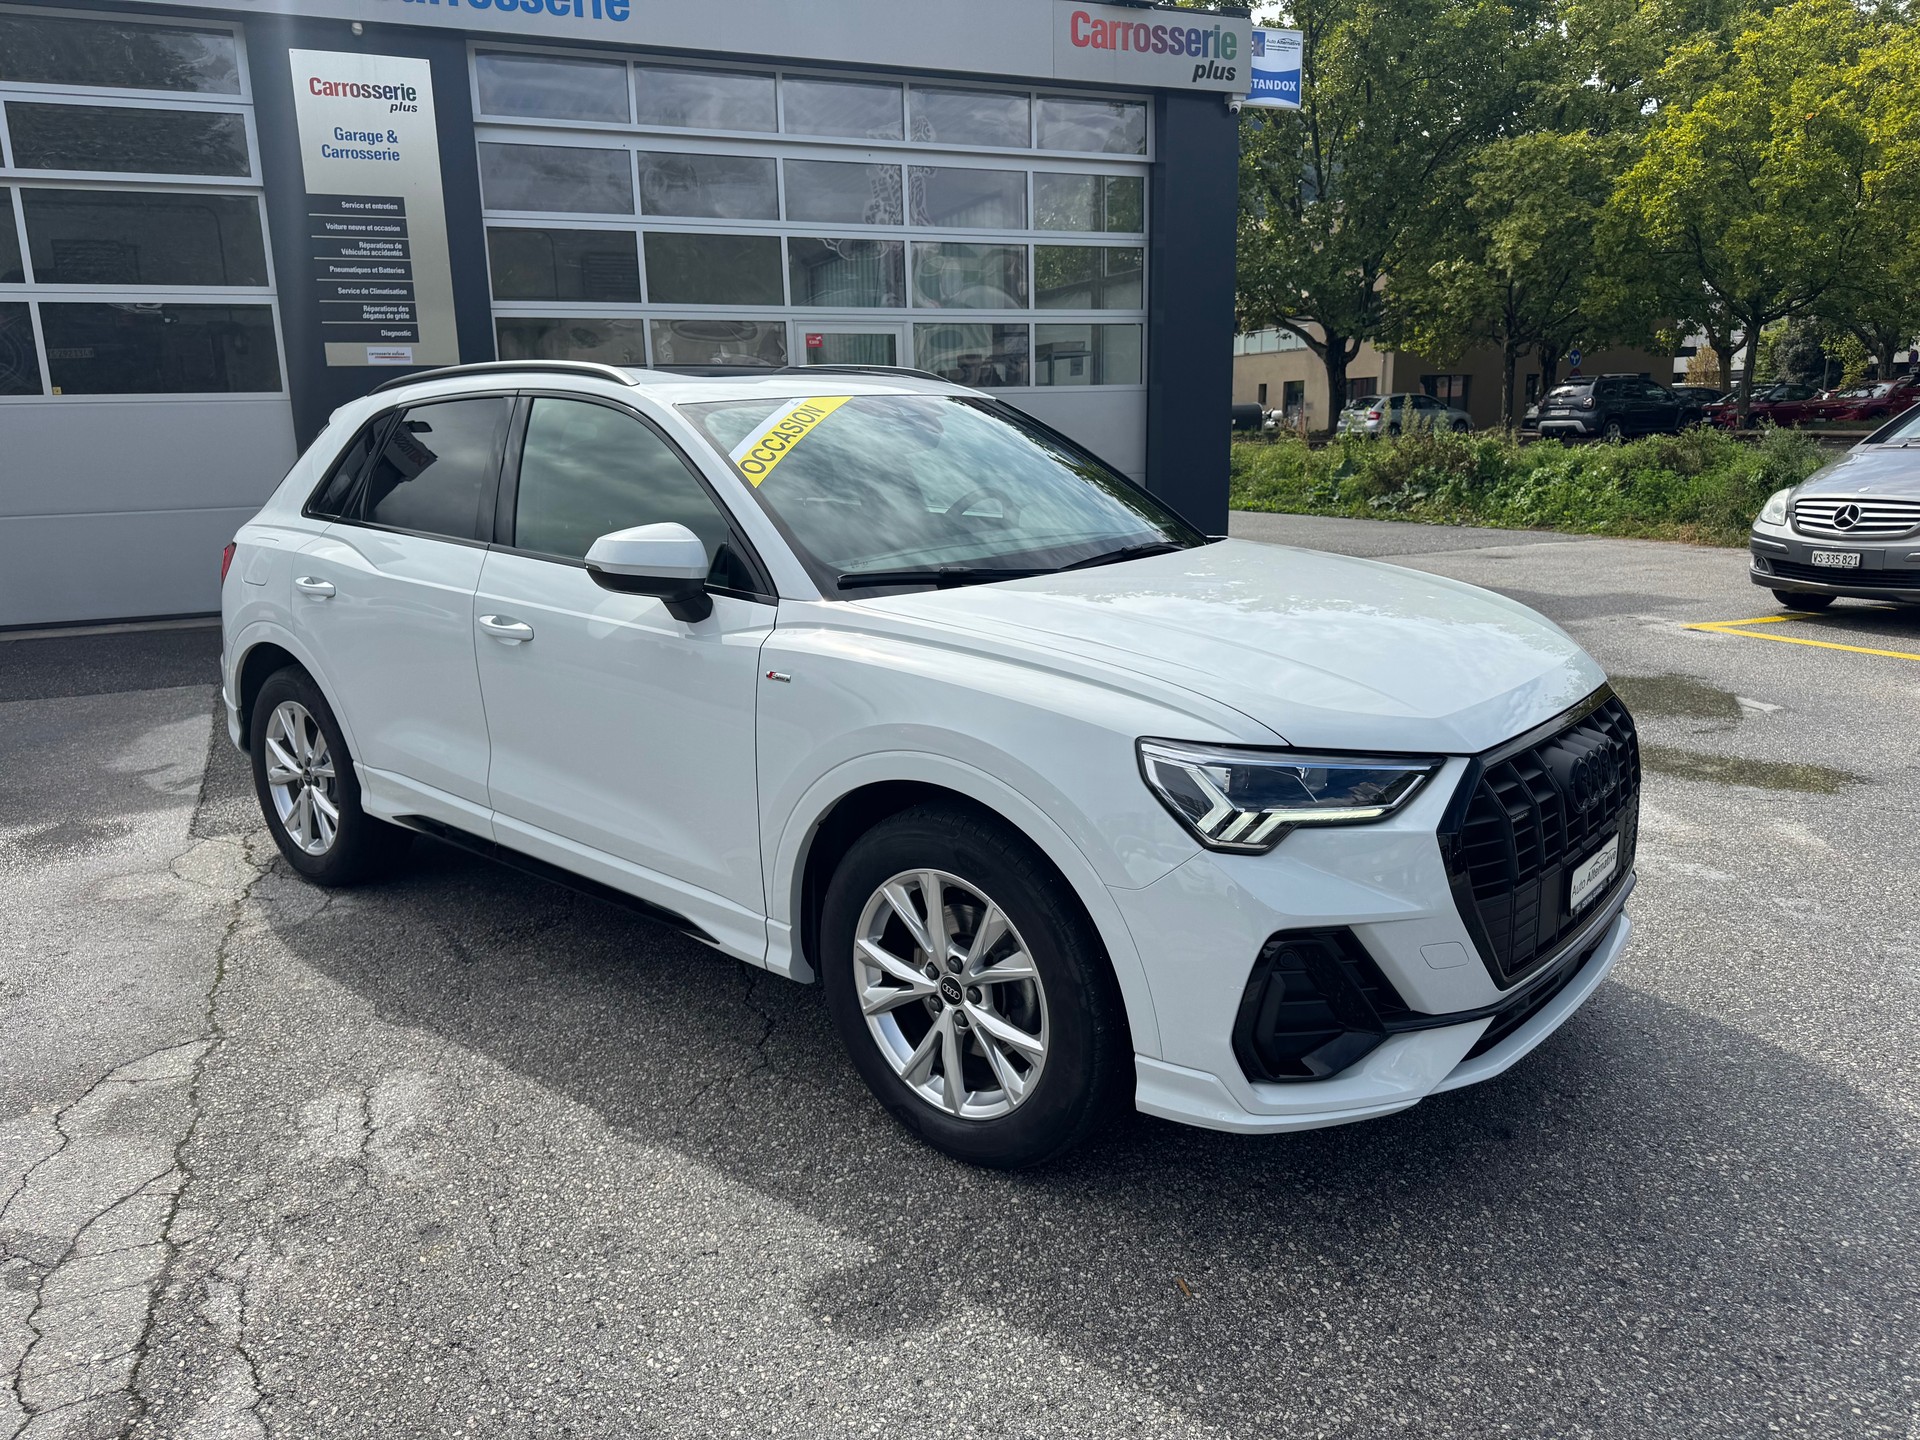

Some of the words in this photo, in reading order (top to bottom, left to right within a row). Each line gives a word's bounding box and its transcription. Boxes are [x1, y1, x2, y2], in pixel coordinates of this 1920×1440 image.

[1070, 10, 1237, 60] Carrosserie
[1192, 60, 1236, 82] plus
[309, 77, 417, 102] Carrosserie
[389, 101, 418, 113] plus
[333, 126, 384, 146] Garage
[386, 129, 399, 144] &
[321, 144, 400, 161] Carrosserie
[341, 201, 364, 209] Service
[372, 202, 398, 210] entretien
[325, 222, 347, 230] Voiture
[358, 241, 394, 250] Réparations
[341, 248, 370, 256] Véhicules
[329, 265, 371, 275] Pneumatiques
[337, 287, 360, 295] Service
[369, 287, 407, 295] Climatisation
[363, 305, 397, 313] Réparations
[380, 329, 412, 338] Diagnostic
[739, 404, 826, 475] OCCASION
[1571, 879, 1586, 898] Auto
[1586, 850, 1616, 885] Alternative
